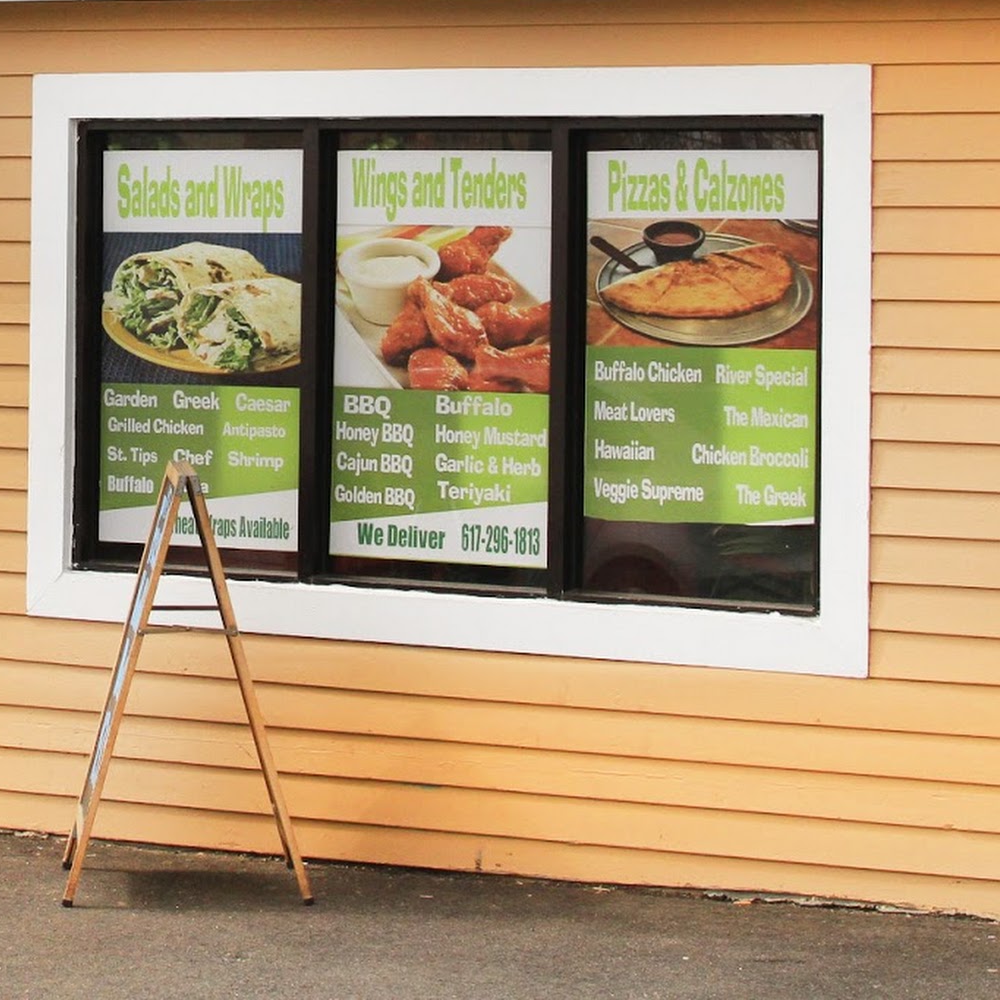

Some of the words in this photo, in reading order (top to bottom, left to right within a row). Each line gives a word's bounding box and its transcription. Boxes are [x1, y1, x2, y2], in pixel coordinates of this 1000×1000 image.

[352, 157, 407, 222] Wings
[412, 157, 445, 208] and
[450, 157, 528, 210] Tenders
[608, 160, 670, 212] Pizzas
[675, 159, 688, 211] &
[693, 157, 785, 213] Calzones
[117, 163, 180, 219] Salads
[185, 165, 219, 218] and
[223, 165, 285, 232] Wraps
[594, 360, 645, 382] Buffalo
[647, 361, 702, 383] Chicken
[715, 363, 752, 385] River
[755, 364, 808, 391] Special
[104, 388, 158, 407] Garden
[173, 389, 220, 410] Greek
[235, 393, 291, 413] Caesar
[343, 394, 391, 419] BBQ
[435, 394, 513, 416] Buffalo
[594, 401, 627, 421] Meat
[630, 402, 675, 423] Lovers
[723, 405, 748, 426] The
[750, 406, 808, 428] Mexican
[108, 417, 151, 433] Grilled
[153, 418, 204, 435] Chicken
[222, 422, 286, 440] Antipasto
[336, 421, 379, 447] Honey
[382, 423, 414, 448] BBQ
[435, 423, 481, 449] Honey
[484, 426, 548, 448] Mustard
[107, 446, 127, 461] St.
[130, 447, 158, 466] Tips
[173, 448, 213, 465] Chef
[228, 450, 284, 471] Shrimp
[594, 439, 655, 461] Hawaiian
[692, 443, 747, 466] Chicken
[750, 445, 809, 468] Broccoli
[336, 452, 377, 476] Cajun
[380, 454, 413, 478] BBQ
[435, 453, 484, 474] Garlic
[487, 456, 498, 475] &
[502, 457, 542, 477] Herb
[107, 475, 154, 493] Buffalo
[437, 481, 511, 505] Teriyaki
[594, 477, 638, 504] Veggie
[641, 478, 704, 506] Supreme
[736, 484, 761, 505] The
[764, 485, 807, 507] Greek
[335, 484, 382, 504] Golden
[384, 487, 415, 510] BBQ
[208, 514, 237, 539] raps
[239, 515, 290, 539] Available
[357, 522, 384, 546] We
[387, 524, 446, 549] Deliver
[461, 523, 540, 556] 617-296-1813
